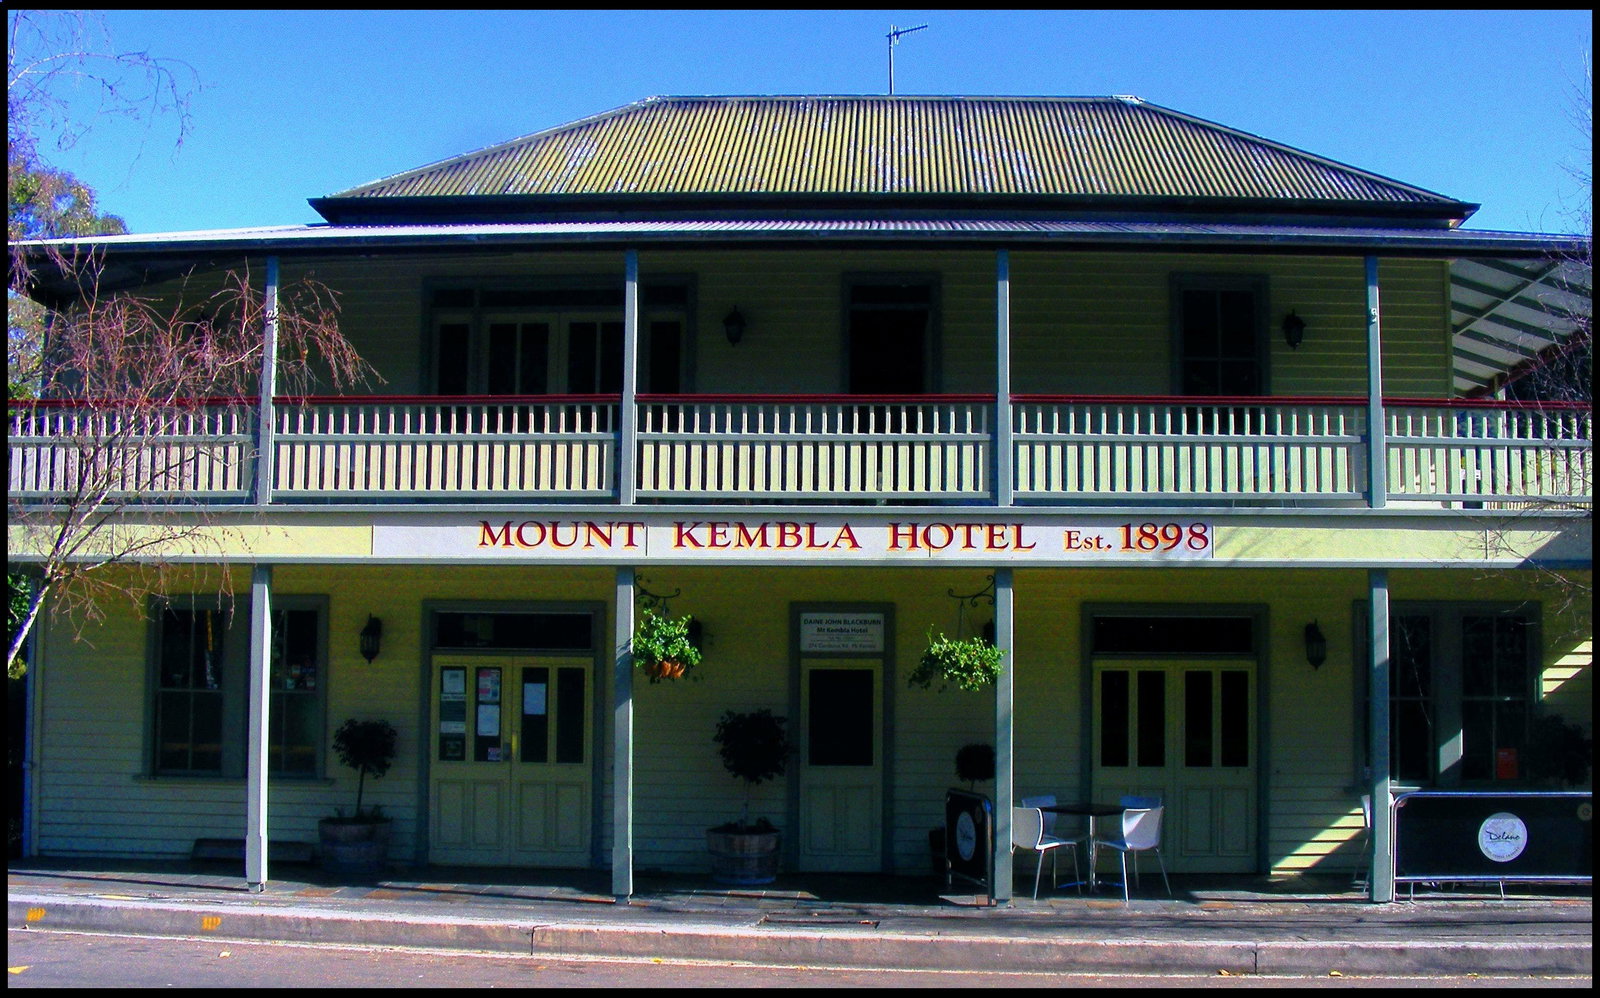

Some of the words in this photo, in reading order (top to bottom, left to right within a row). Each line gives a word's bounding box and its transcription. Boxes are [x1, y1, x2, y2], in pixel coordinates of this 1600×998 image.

[478, 520, 645, 549] MOUNT
[673, 521, 863, 551] KEMBLA
[887, 522, 1037, 552] HOTEL
[1063, 529, 1112, 551] Est.
[1119, 522, 1209, 552] 1898
